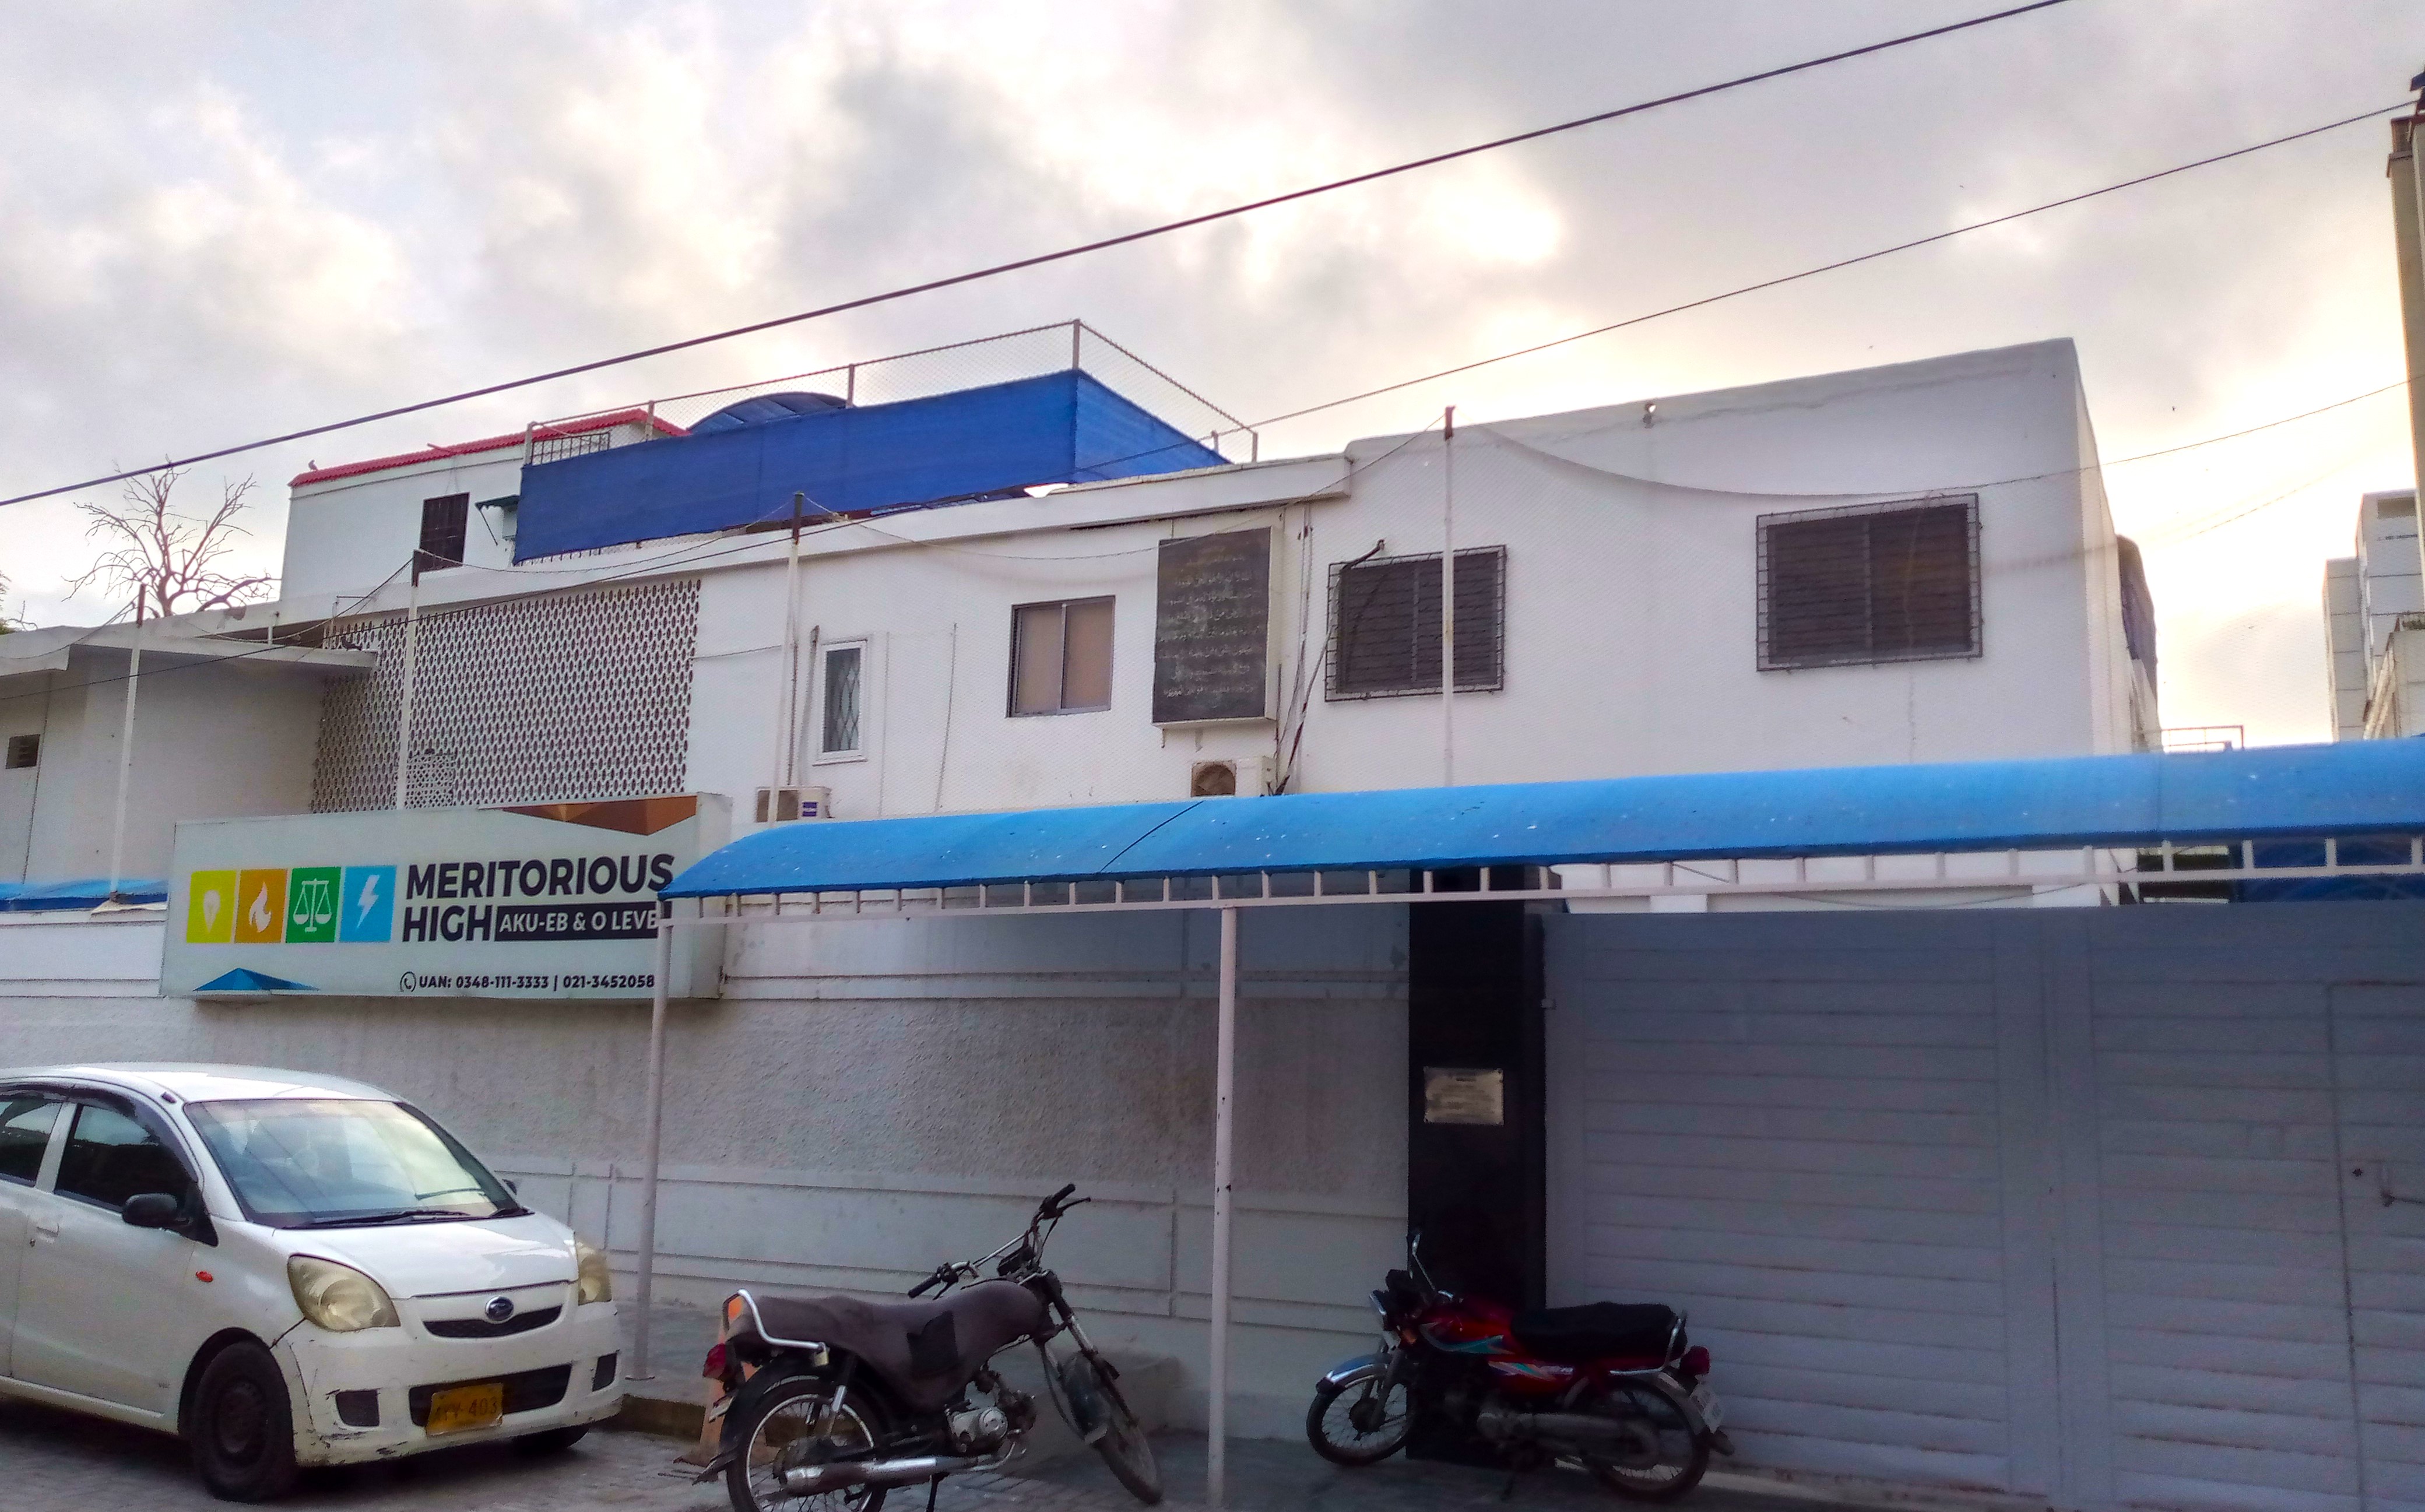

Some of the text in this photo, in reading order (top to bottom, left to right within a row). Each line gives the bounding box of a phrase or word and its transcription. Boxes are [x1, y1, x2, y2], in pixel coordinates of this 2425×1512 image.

[406, 853, 674, 899] MERITORIOUS
[402, 904, 494, 943] HIGH
[499, 909, 658, 933] AKU-EB & O LEVE
[419, 975, 452, 989] UAN:
[456, 975, 549, 989] 0348-111-3333
[563, 974, 655, 989] 021-3452058
